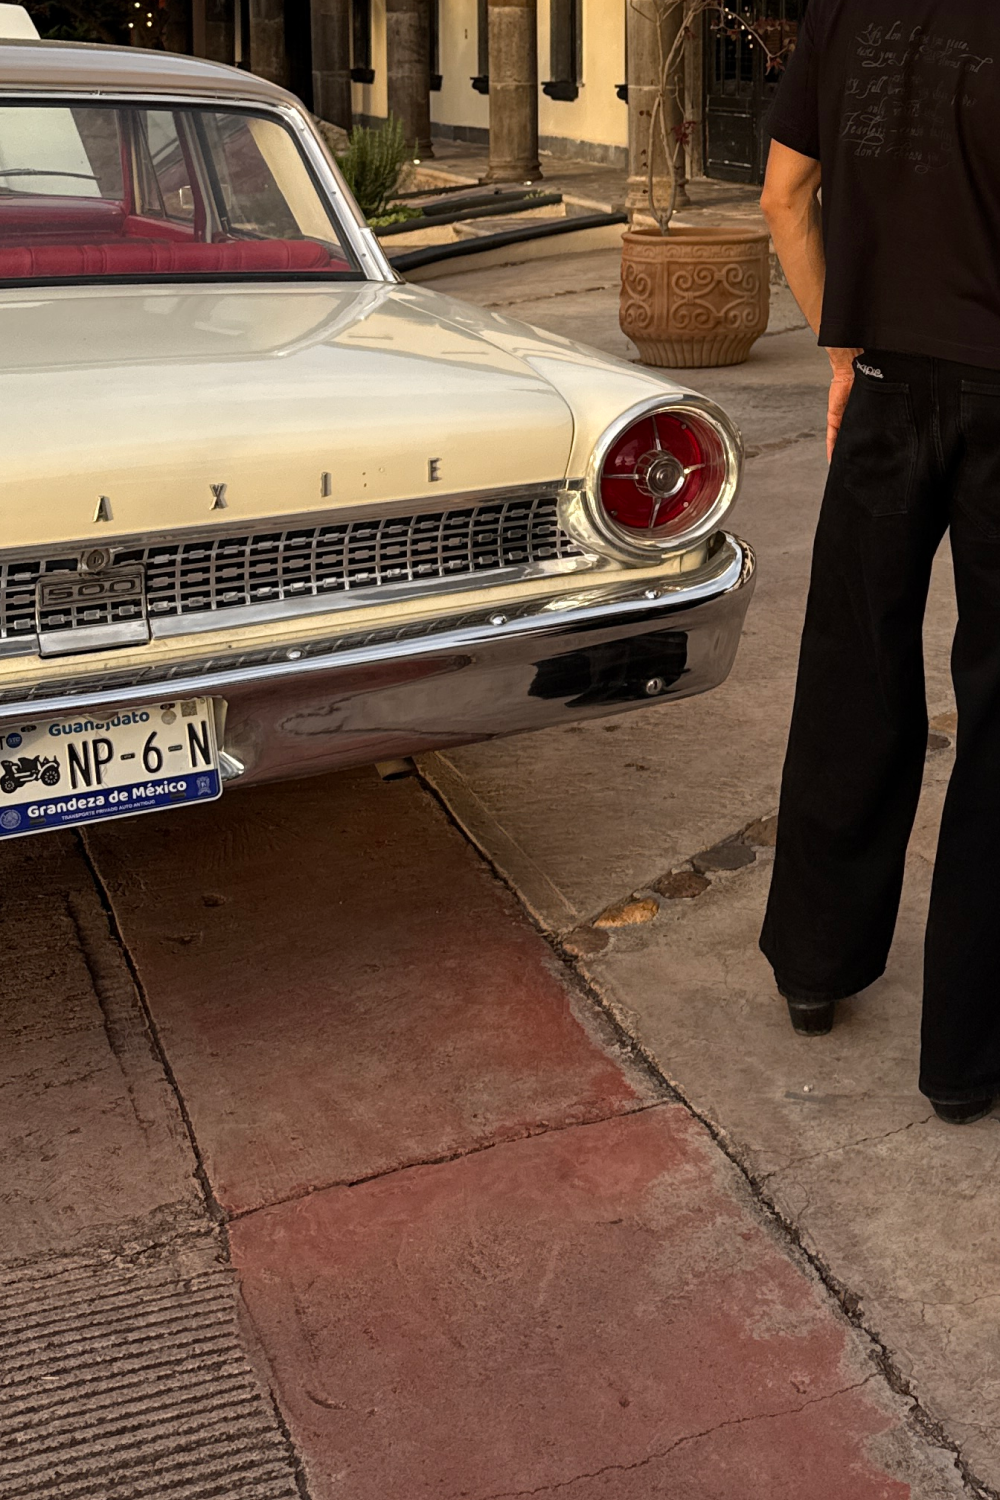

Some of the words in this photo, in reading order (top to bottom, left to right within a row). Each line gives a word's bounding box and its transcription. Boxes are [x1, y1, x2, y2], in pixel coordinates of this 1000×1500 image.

[48, 579, 136, 600] 500
[27, 793, 105, 818] Grandeza
[109, 790, 129, 804] de
[132, 780, 187, 799] México
